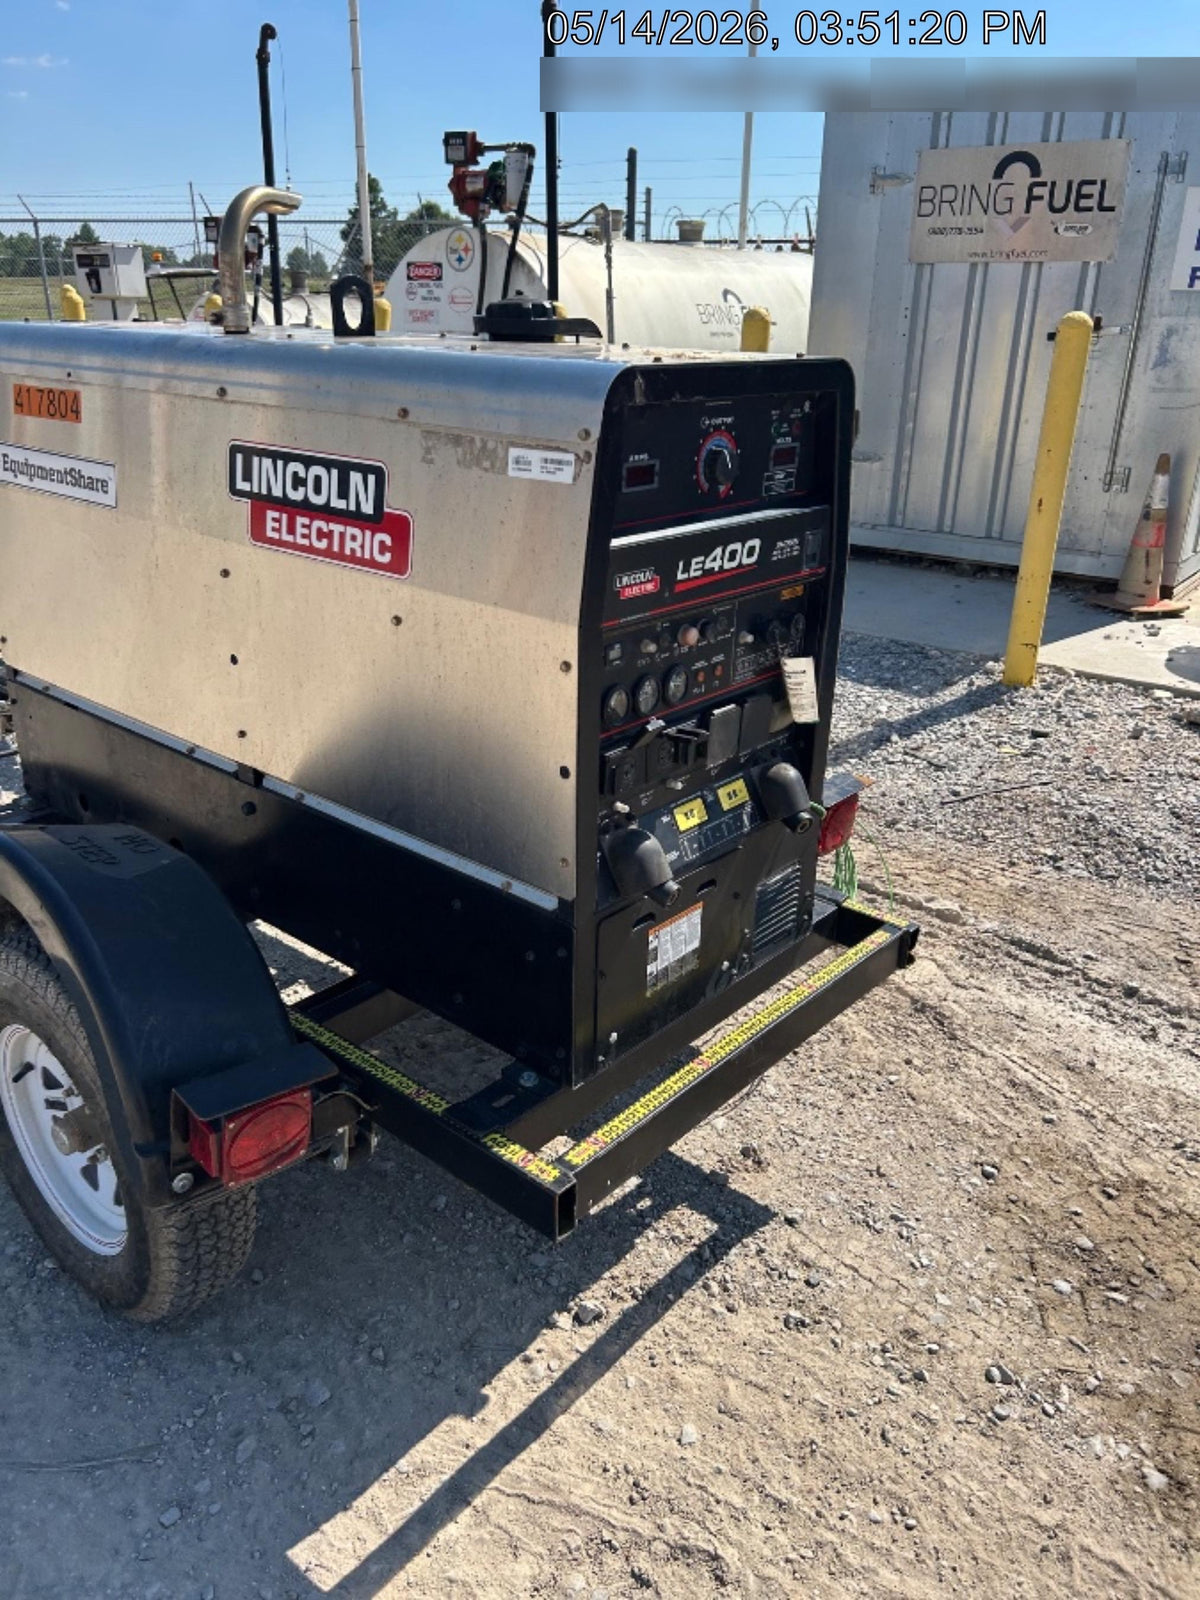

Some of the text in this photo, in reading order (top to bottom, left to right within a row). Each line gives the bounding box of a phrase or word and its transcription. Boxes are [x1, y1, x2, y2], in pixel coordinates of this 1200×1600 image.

[917, 179, 1117, 217] BRING FUEL
[15, 385, 80, 419] 417804
[2, 453, 109, 494] EquipmentShare
[235, 453, 375, 514] LINCOLN
[266, 510, 392, 563] ELECTRIC
[616, 570, 653, 587] LINCOLN
[677, 538, 761, 580] LE400
[602, 1124, 619, 1138] DO
[620, 1108, 641, 1125] NOT
